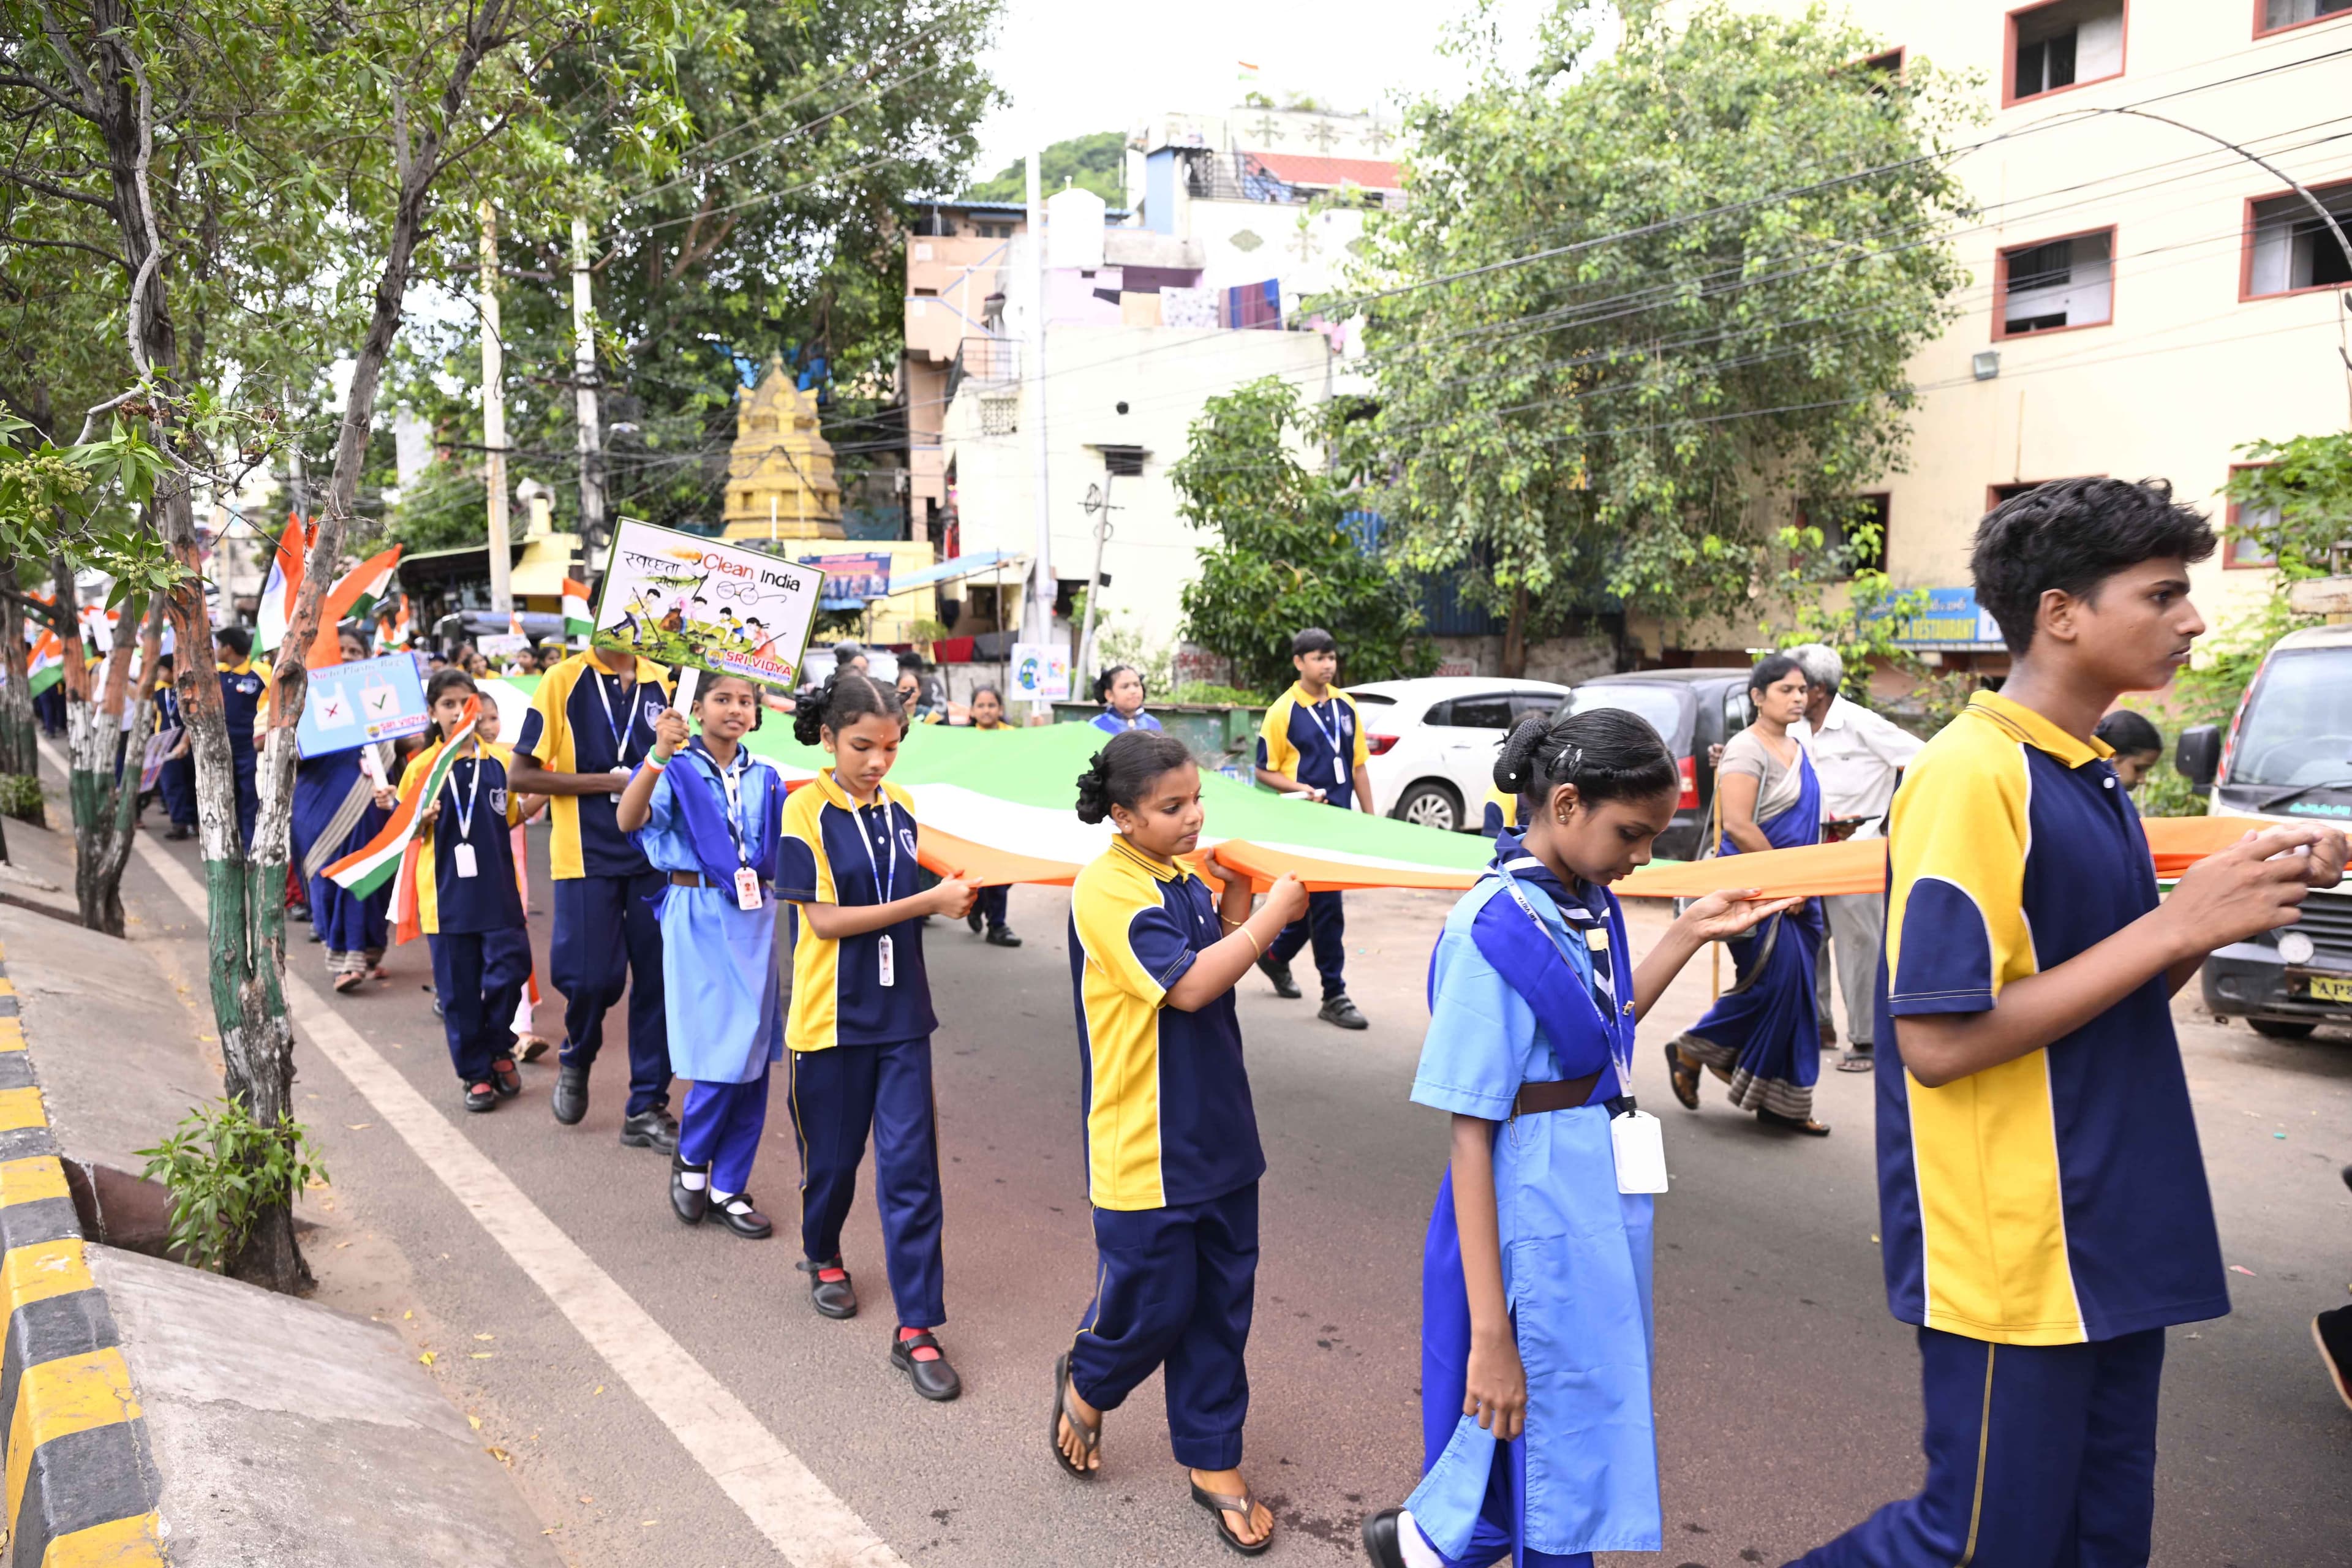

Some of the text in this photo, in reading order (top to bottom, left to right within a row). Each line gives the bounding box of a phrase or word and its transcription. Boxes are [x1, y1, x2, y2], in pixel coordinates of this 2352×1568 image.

[703, 554, 801, 592] Clean India
[1912, 619, 1976, 640] RESTAURANT
[726, 651, 748, 665] SRI
[752, 657, 791, 676] VIDYA
